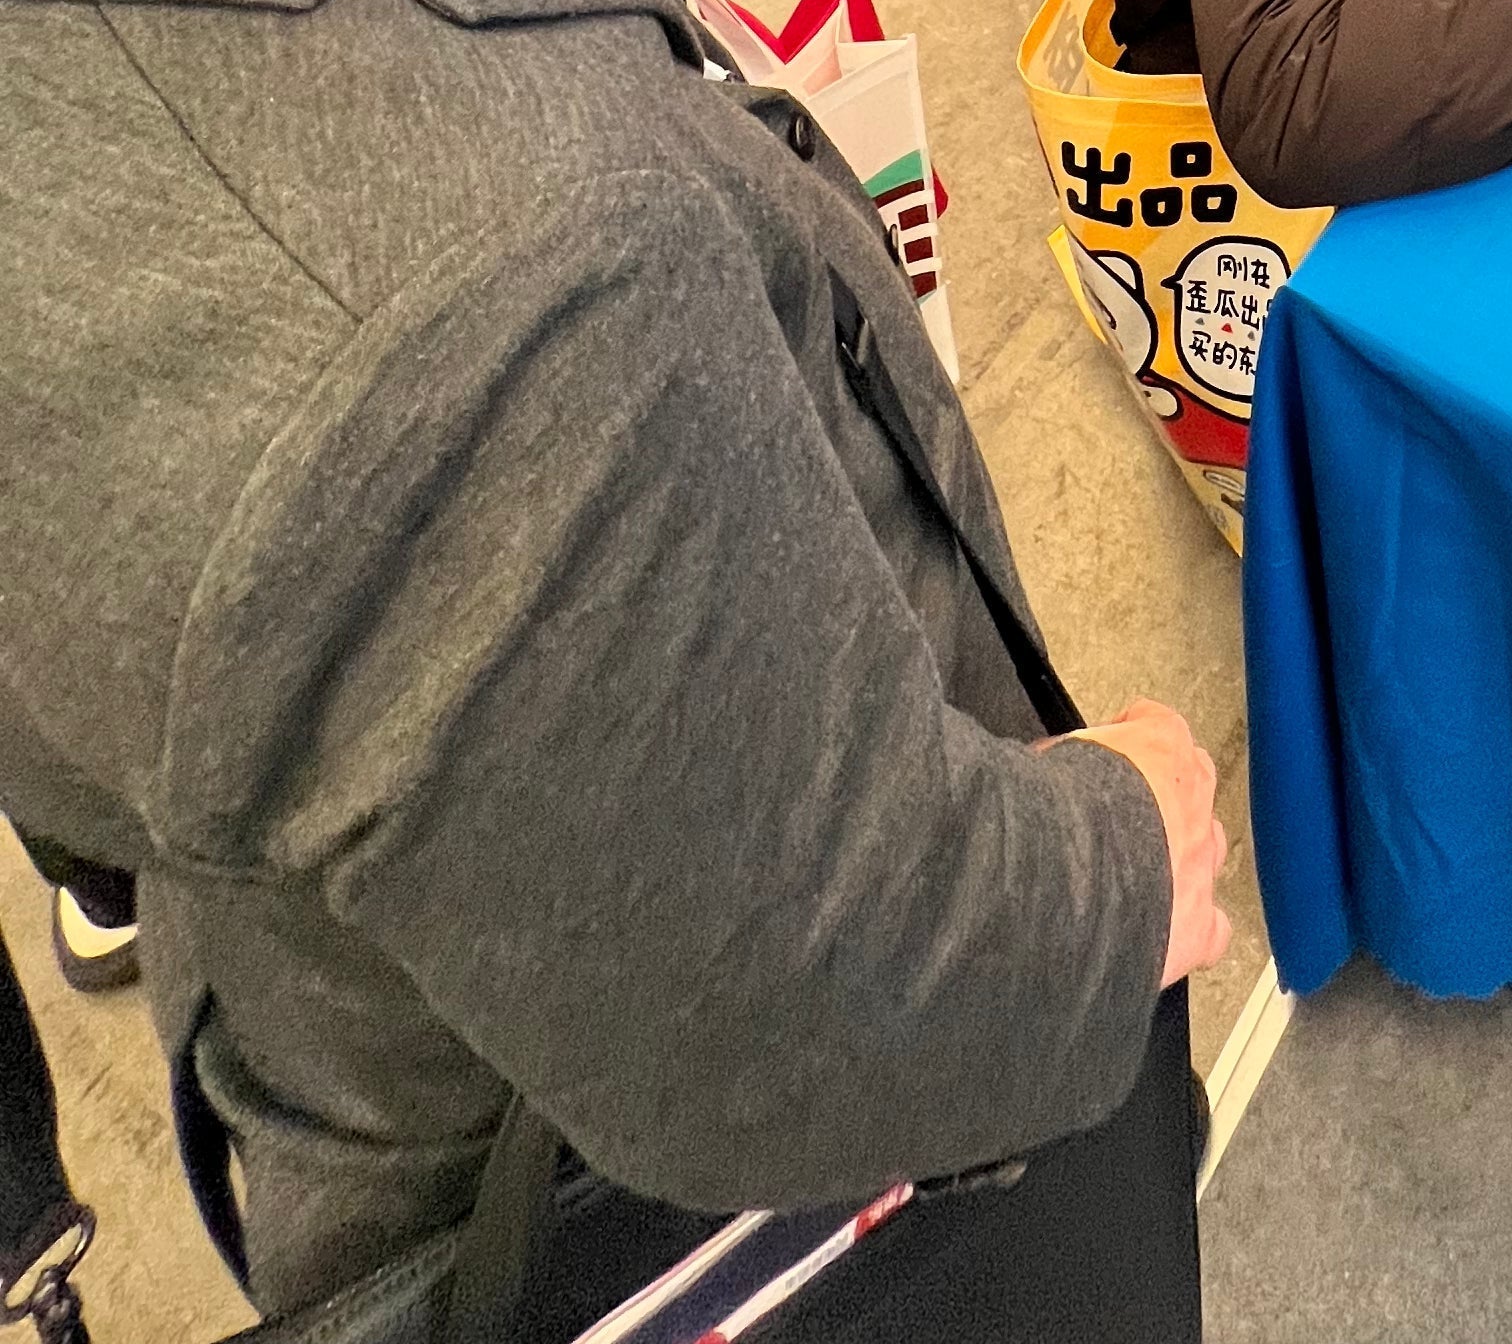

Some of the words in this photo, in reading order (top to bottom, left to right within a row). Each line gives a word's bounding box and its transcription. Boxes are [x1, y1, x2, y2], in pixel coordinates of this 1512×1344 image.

[1061, 140, 1239, 228] 出品
[1217, 254, 1270, 290] 刚在
[1185, 279, 1273, 332] 歪瓜出
